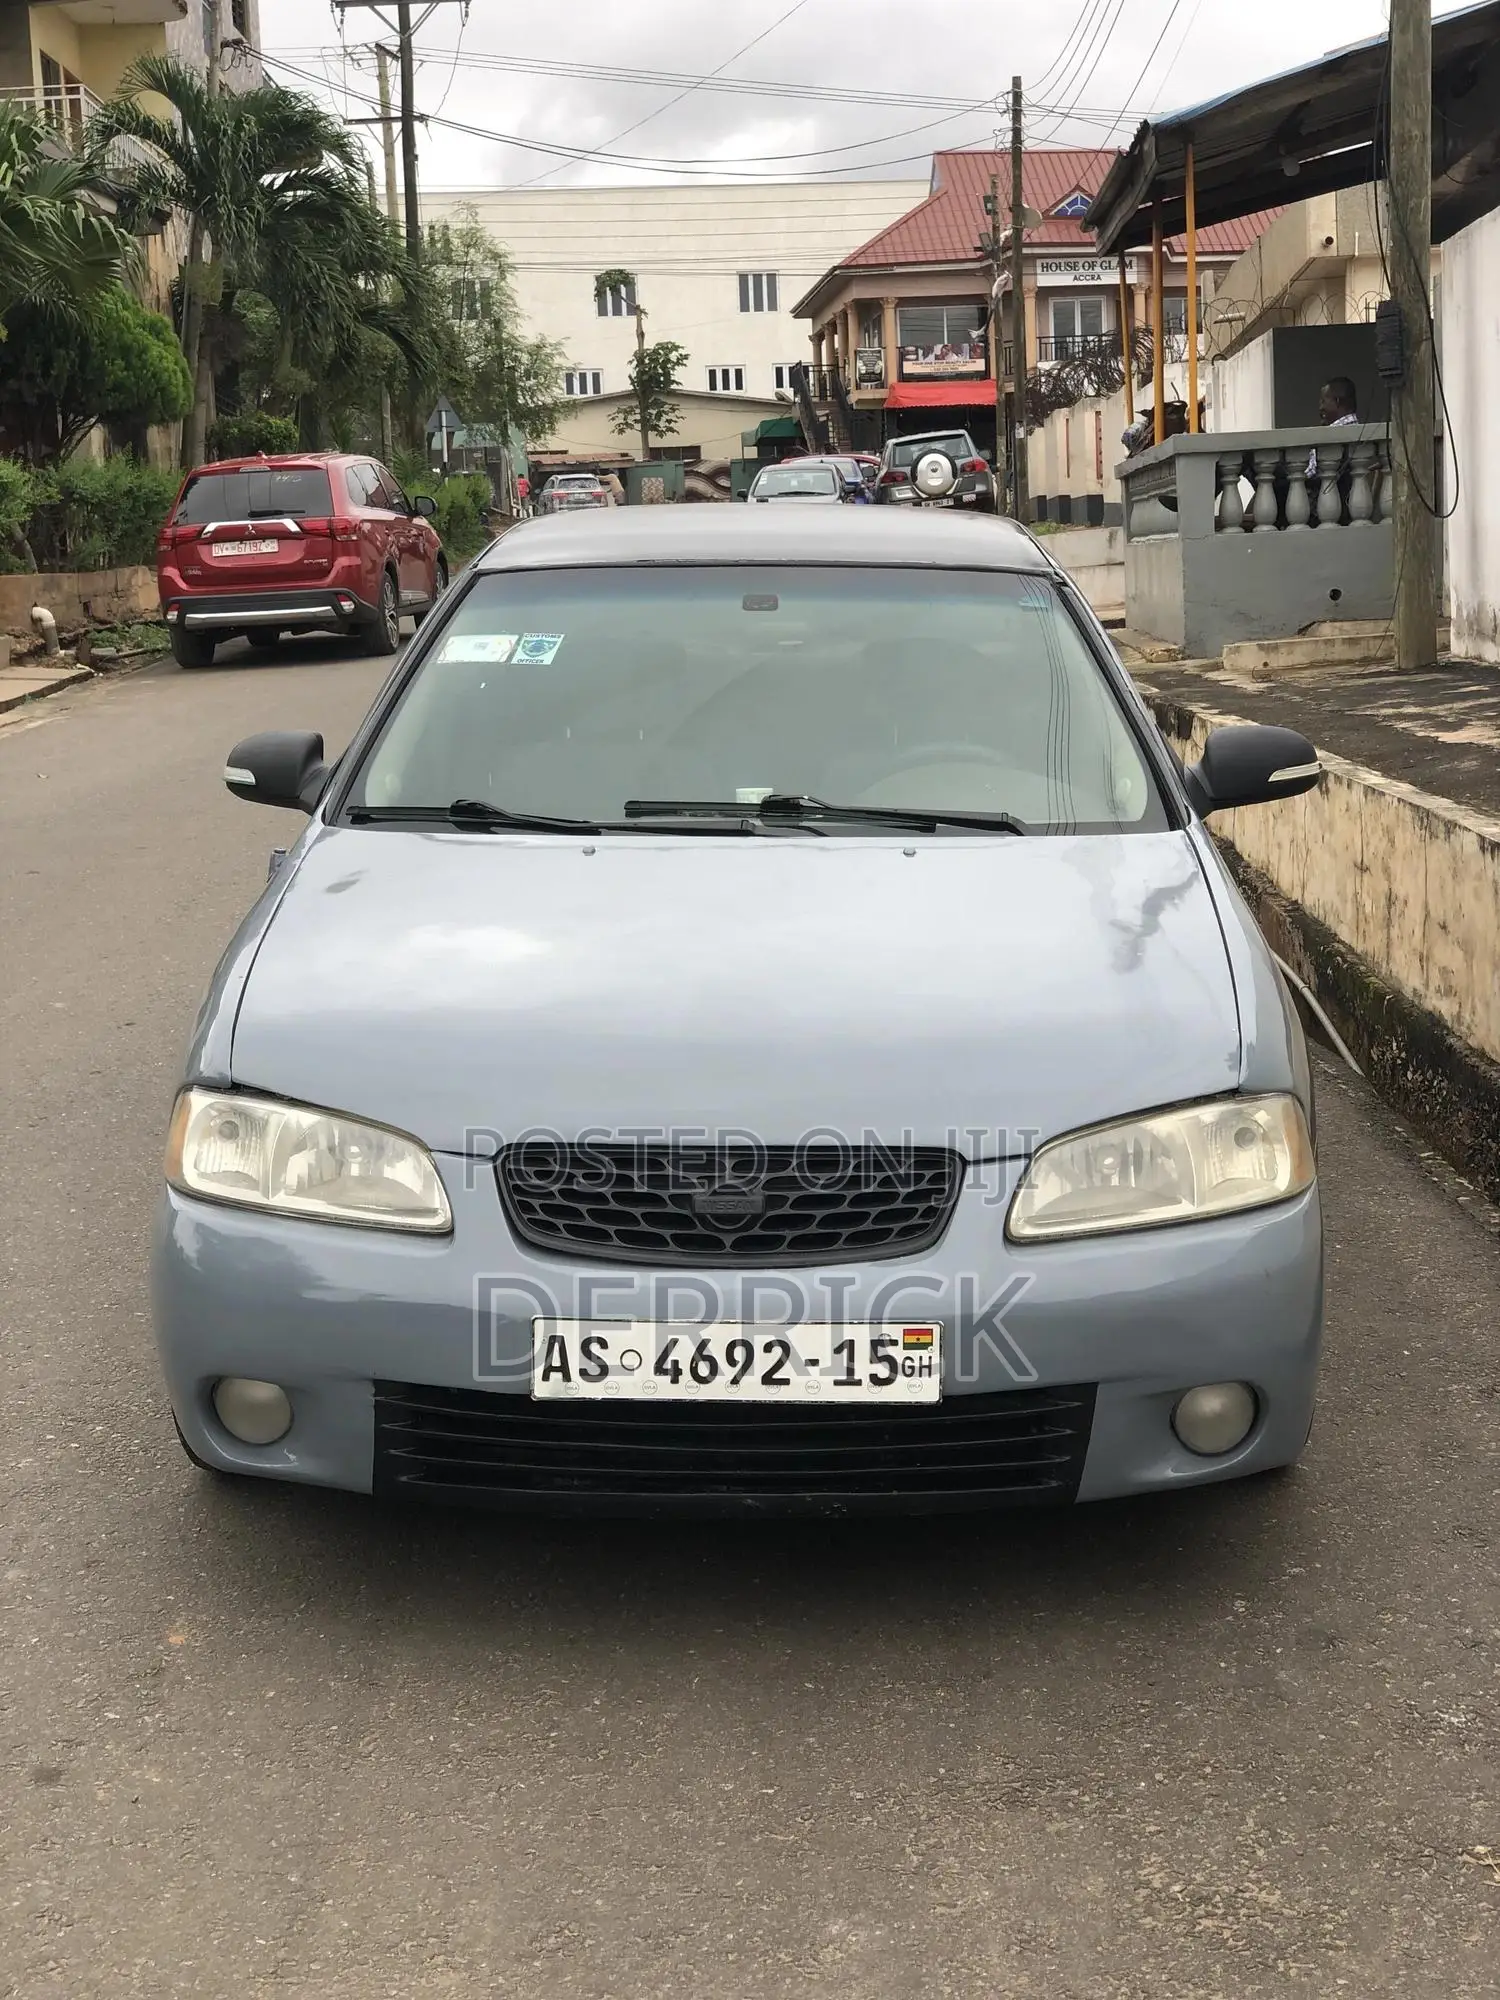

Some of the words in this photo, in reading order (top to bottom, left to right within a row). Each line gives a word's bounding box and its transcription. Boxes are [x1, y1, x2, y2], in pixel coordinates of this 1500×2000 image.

[1041, 262, 1080, 273] HOUSE
[1082, 261, 1098, 272] OF
[1073, 274, 1102, 282] ACCRA
[541, 1335, 608, 1382] AS
[901, 1355, 933, 1378] GH
